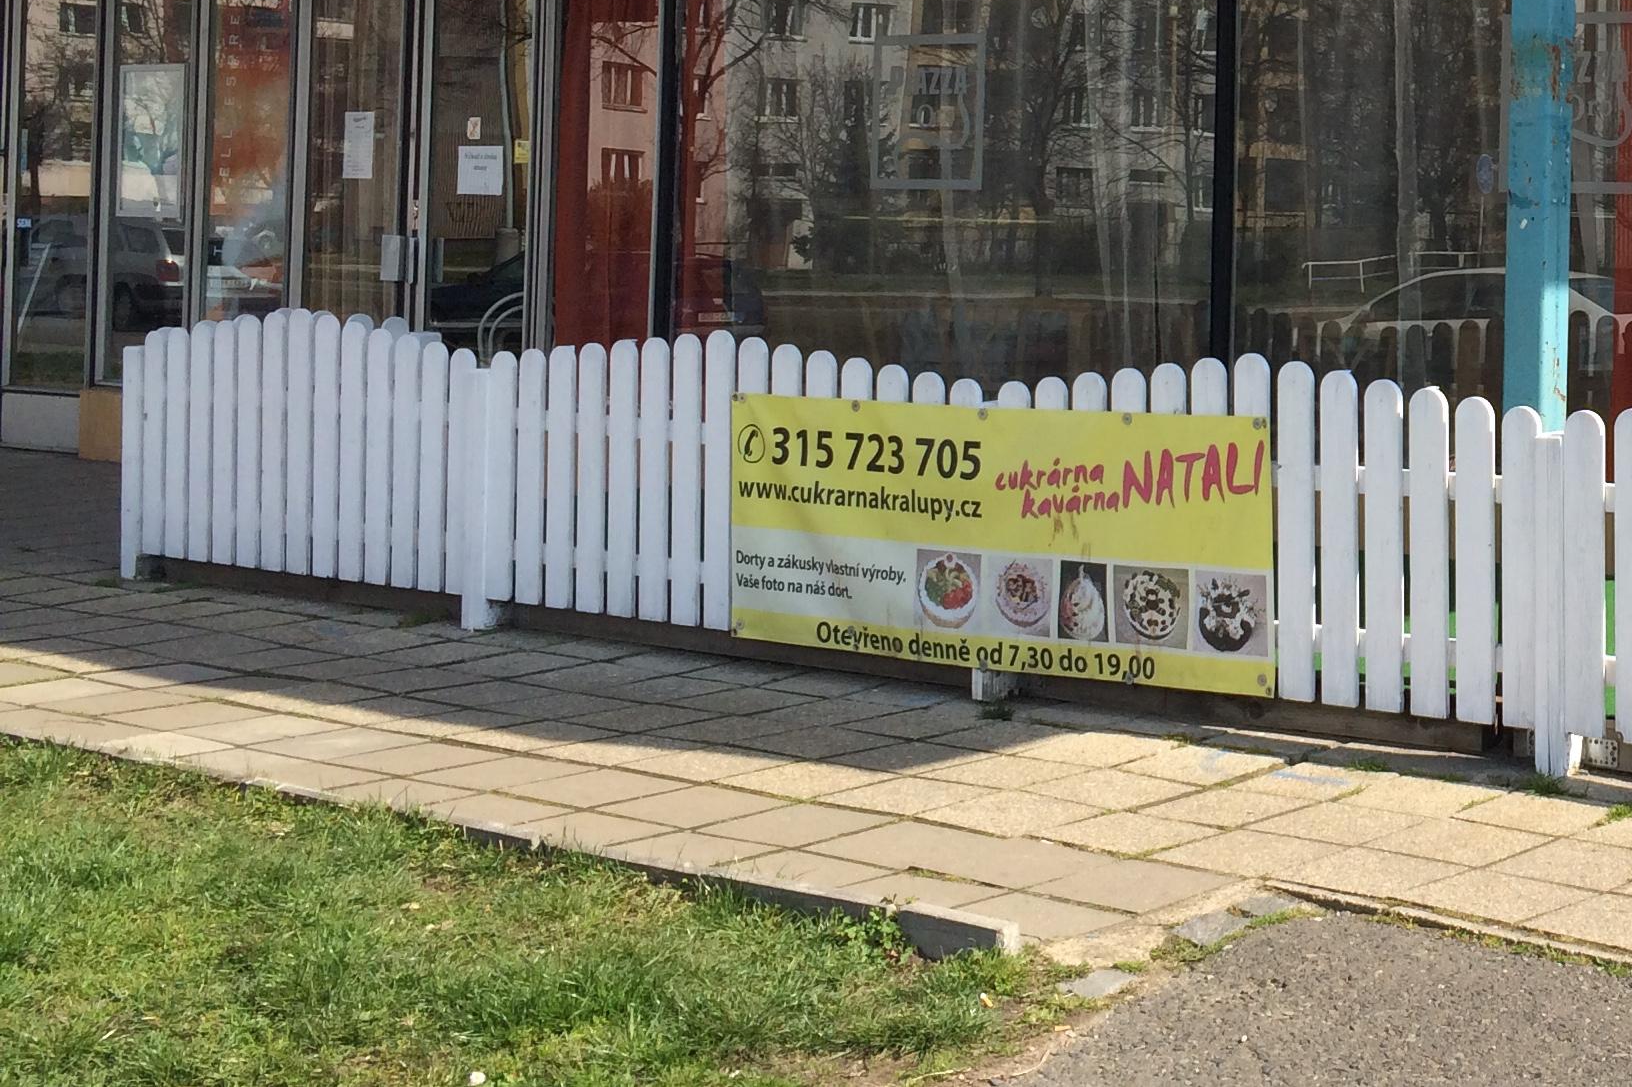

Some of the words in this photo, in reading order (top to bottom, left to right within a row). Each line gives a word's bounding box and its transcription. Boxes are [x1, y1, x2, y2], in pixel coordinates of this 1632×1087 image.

[771, 427, 834, 469] 315
[845, 432, 905, 475] 723
[915, 437, 982, 481] 705
[994, 457, 1105, 491] cukrárna
[1121, 439, 1265, 509] NATALI
[738, 480, 983, 523] www.cukrarnakralupy.cz
[1020, 484, 1121, 520] kavárna
[736, 549, 766, 570] Dorty
[767, 557, 774, 568] a
[776, 554, 825, 576] zákusky
[826, 559, 860, 578] vlastní
[861, 562, 907, 586] výroby.
[736, 572, 760, 589] Vaše
[761, 576, 785, 592] foto
[787, 581, 803, 593] na
[805, 580, 826, 596] náš
[816, 620, 903, 654] Otevřeno
[908, 632, 970, 663] denně
[976, 641, 1002, 667] od
[1009, 644, 1053, 673] 7,30
[1059, 649, 1088, 674] do
